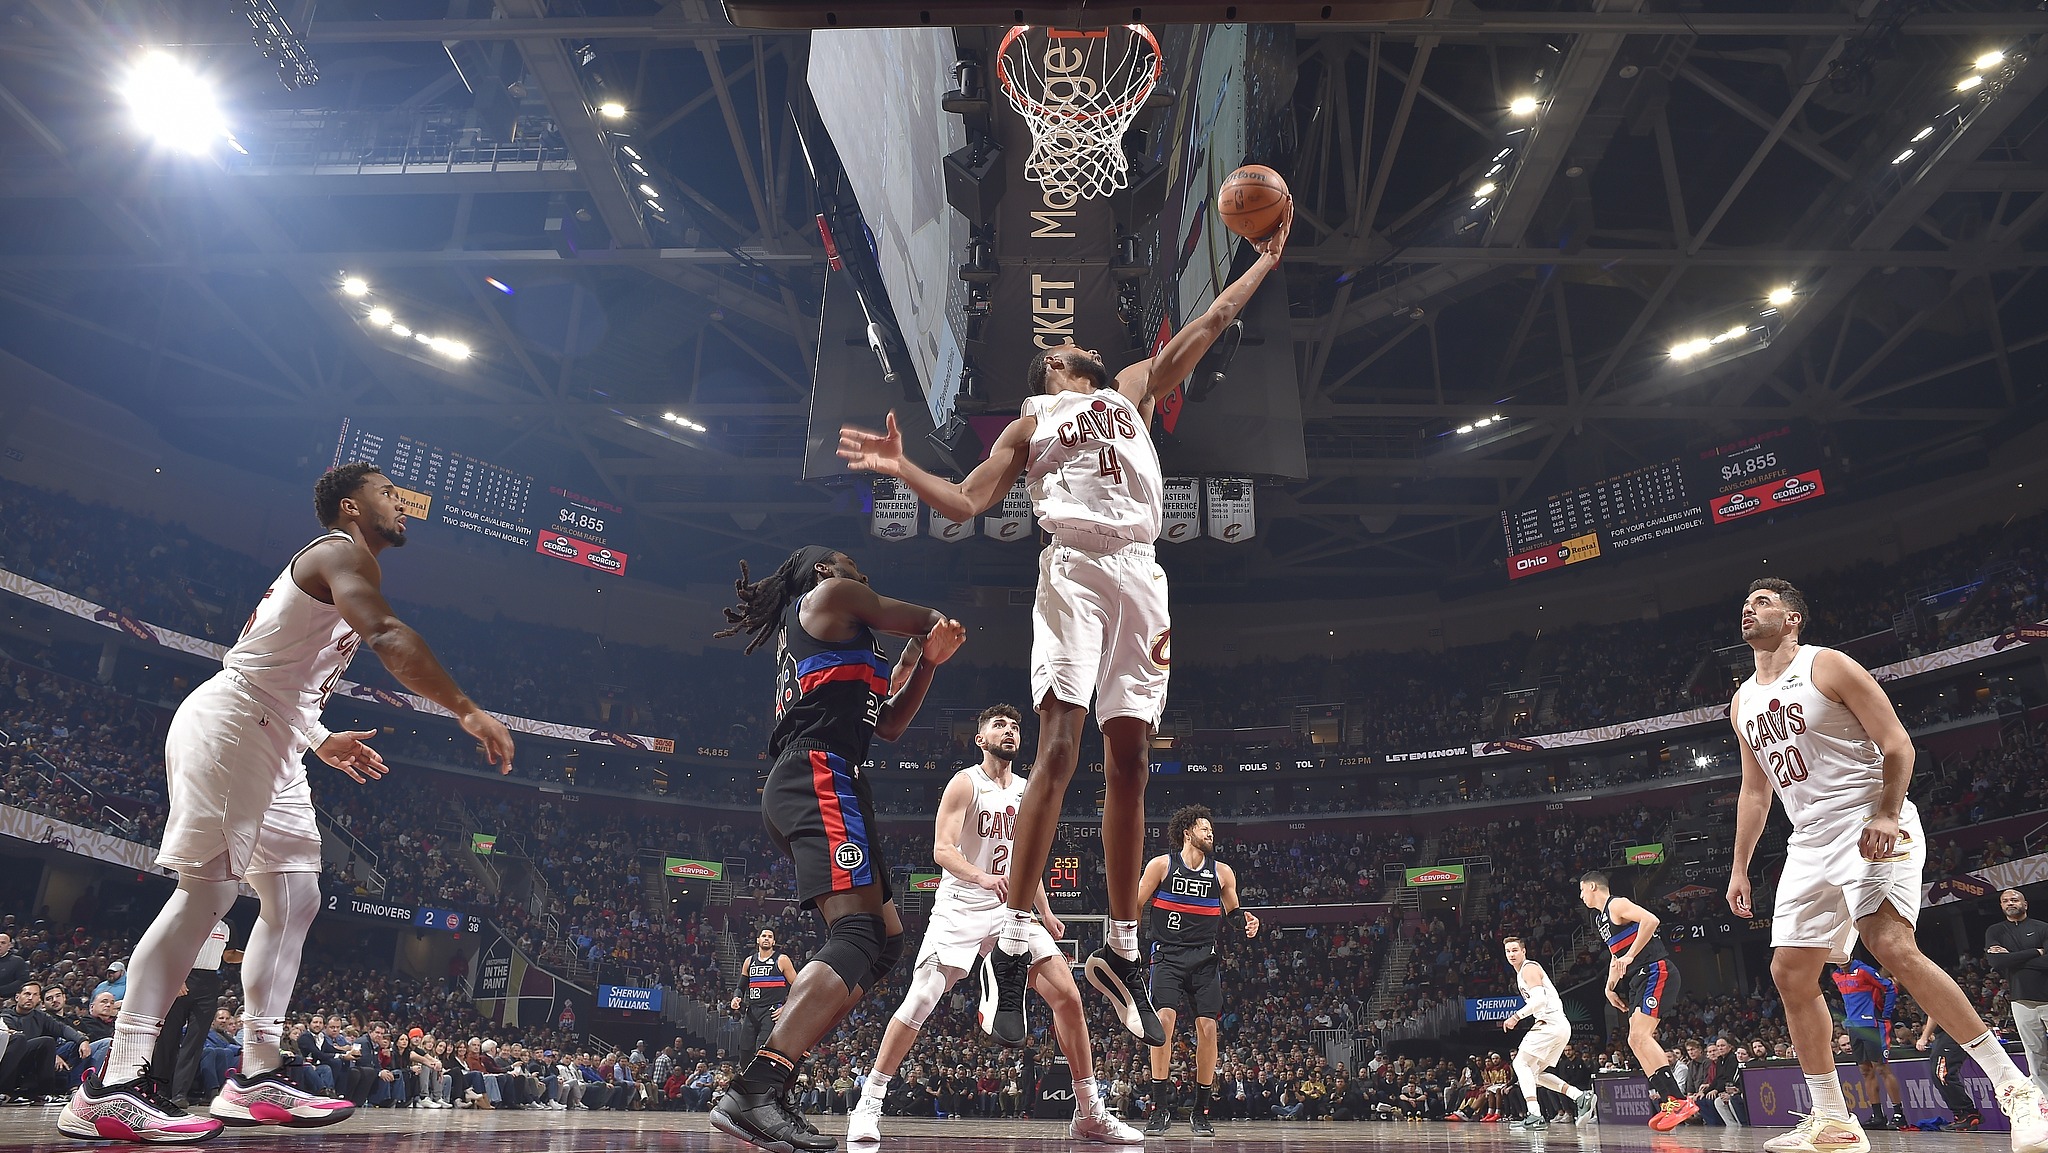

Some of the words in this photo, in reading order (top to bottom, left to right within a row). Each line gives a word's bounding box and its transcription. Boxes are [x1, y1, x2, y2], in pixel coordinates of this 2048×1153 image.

[1225, 170, 1268, 185] ilson
[1033, 274, 1075, 350] CKET
[1058, 407, 1136, 448] CAVS
[1099, 444, 1122, 485] 4
[1721, 452, 1777, 481] $4,855
[894, 492, 911, 501] TERN
[1004, 492, 1024, 500] TERN
[1163, 493, 1191, 501] ASTERN
[1772, 482, 1816, 500] GEORGIO'S
[400, 496, 427, 511] Rental
[875, 501, 917, 510] CONFERENCE
[1002, 501, 1030, 509] FERENCE
[1163, 502, 1197, 510] NFERENCE
[1718, 498, 1760, 515] GEORGIO'S
[445, 504, 460, 514] FOR
[461, 509, 479, 520] YOUR
[480, 515, 515, 531] CAVALIERS
[515, 525, 532, 535] WITH
[559, 508, 604, 532] $4,855
[875, 511, 915, 519] CHAMPIONS
[1002, 510, 1028, 518] MPIONS
[1162, 511, 1196, 519] HAMPIONS
[442, 516, 459, 526] TWO
[484, 527, 501, 539] EVAN
[1611, 529, 1626, 537] FOR
[1626, 522, 1645, 533] YOUR
[1646, 511, 1683, 527] CAVALIERS
[1682, 506, 1702, 517] WITH
[1612, 539, 1628, 549] TWO
[1655, 525, 1673, 537] EVAN
[543, 541, 578, 556] GEORGIO'S
[587, 553, 621, 568] GEORGIO'S
[1516, 556, 1548, 570] Ohio
[1558, 549, 1569, 558] CAT
[1571, 542, 1597, 554] Rental
[120, 616, 148, 640] FENSE
[1781, 682, 1804, 690] CLIFFS
[1746, 702, 1807, 751] CAVS
[655, 739, 673, 747] 50/50
[697, 746, 729, 757] $4,855
[1385, 753, 1408, 762] LET
[1409, 752, 1427, 761] EM
[1428, 747, 1468, 759] KNOW.
[880, 761, 886, 769] 2
[1088, 763, 1104, 772] 1Q
[1149, 763, 1162, 773] 17
[1239, 763, 1268, 771] FOULS
[1275, 762, 1281, 771] 3
[1295, 760, 1313, 769] TOL
[1319, 759, 1326, 768] 7
[1339, 758, 1356, 766] 7:32
[1358, 757, 1371, 765] PM
[1768, 745, 1809, 788] 20
[1187, 764, 1208, 772] FG%
[1211, 764, 1224, 773] 38
[977, 810, 1018, 840] CAV
[840, 851, 859, 861] DET
[991, 845, 1009, 875] 2
[1054, 857, 1079, 868] 2:53
[678, 866, 709, 875] SERVPRO
[1420, 873, 1451, 881] SERVPRO
[1050, 868, 1077, 888] 24
[1171, 876, 1212, 898] DET
[1939, 881, 1948, 890] DE
[1952, 880, 1984, 896] FENSE
[328, 895, 338, 910] 2
[351, 900, 411, 920] TURNOVERS
[424, 911, 434, 925] 2
[468, 915, 482, 924] FG%
[1167, 911, 1181, 930] 2
[468, 923, 479, 933] 38
[1691, 925, 1706, 938] 21
[1719, 923, 1730, 932] 1Q
[1749, 919, 1771, 930] 2:53
[484, 966, 493, 977] IN
[493, 965, 508, 976] THE
[750, 965, 773, 977] DET
[482, 977, 507, 989] PAINT
[609, 986, 651, 1000] SHERWIN
[750, 987, 761, 999] 12
[1476, 998, 1517, 1009] SHERWIN
[1614, 1083, 1647, 1099] PLANET
[1615, 1101, 1650, 1116] FITNESS
